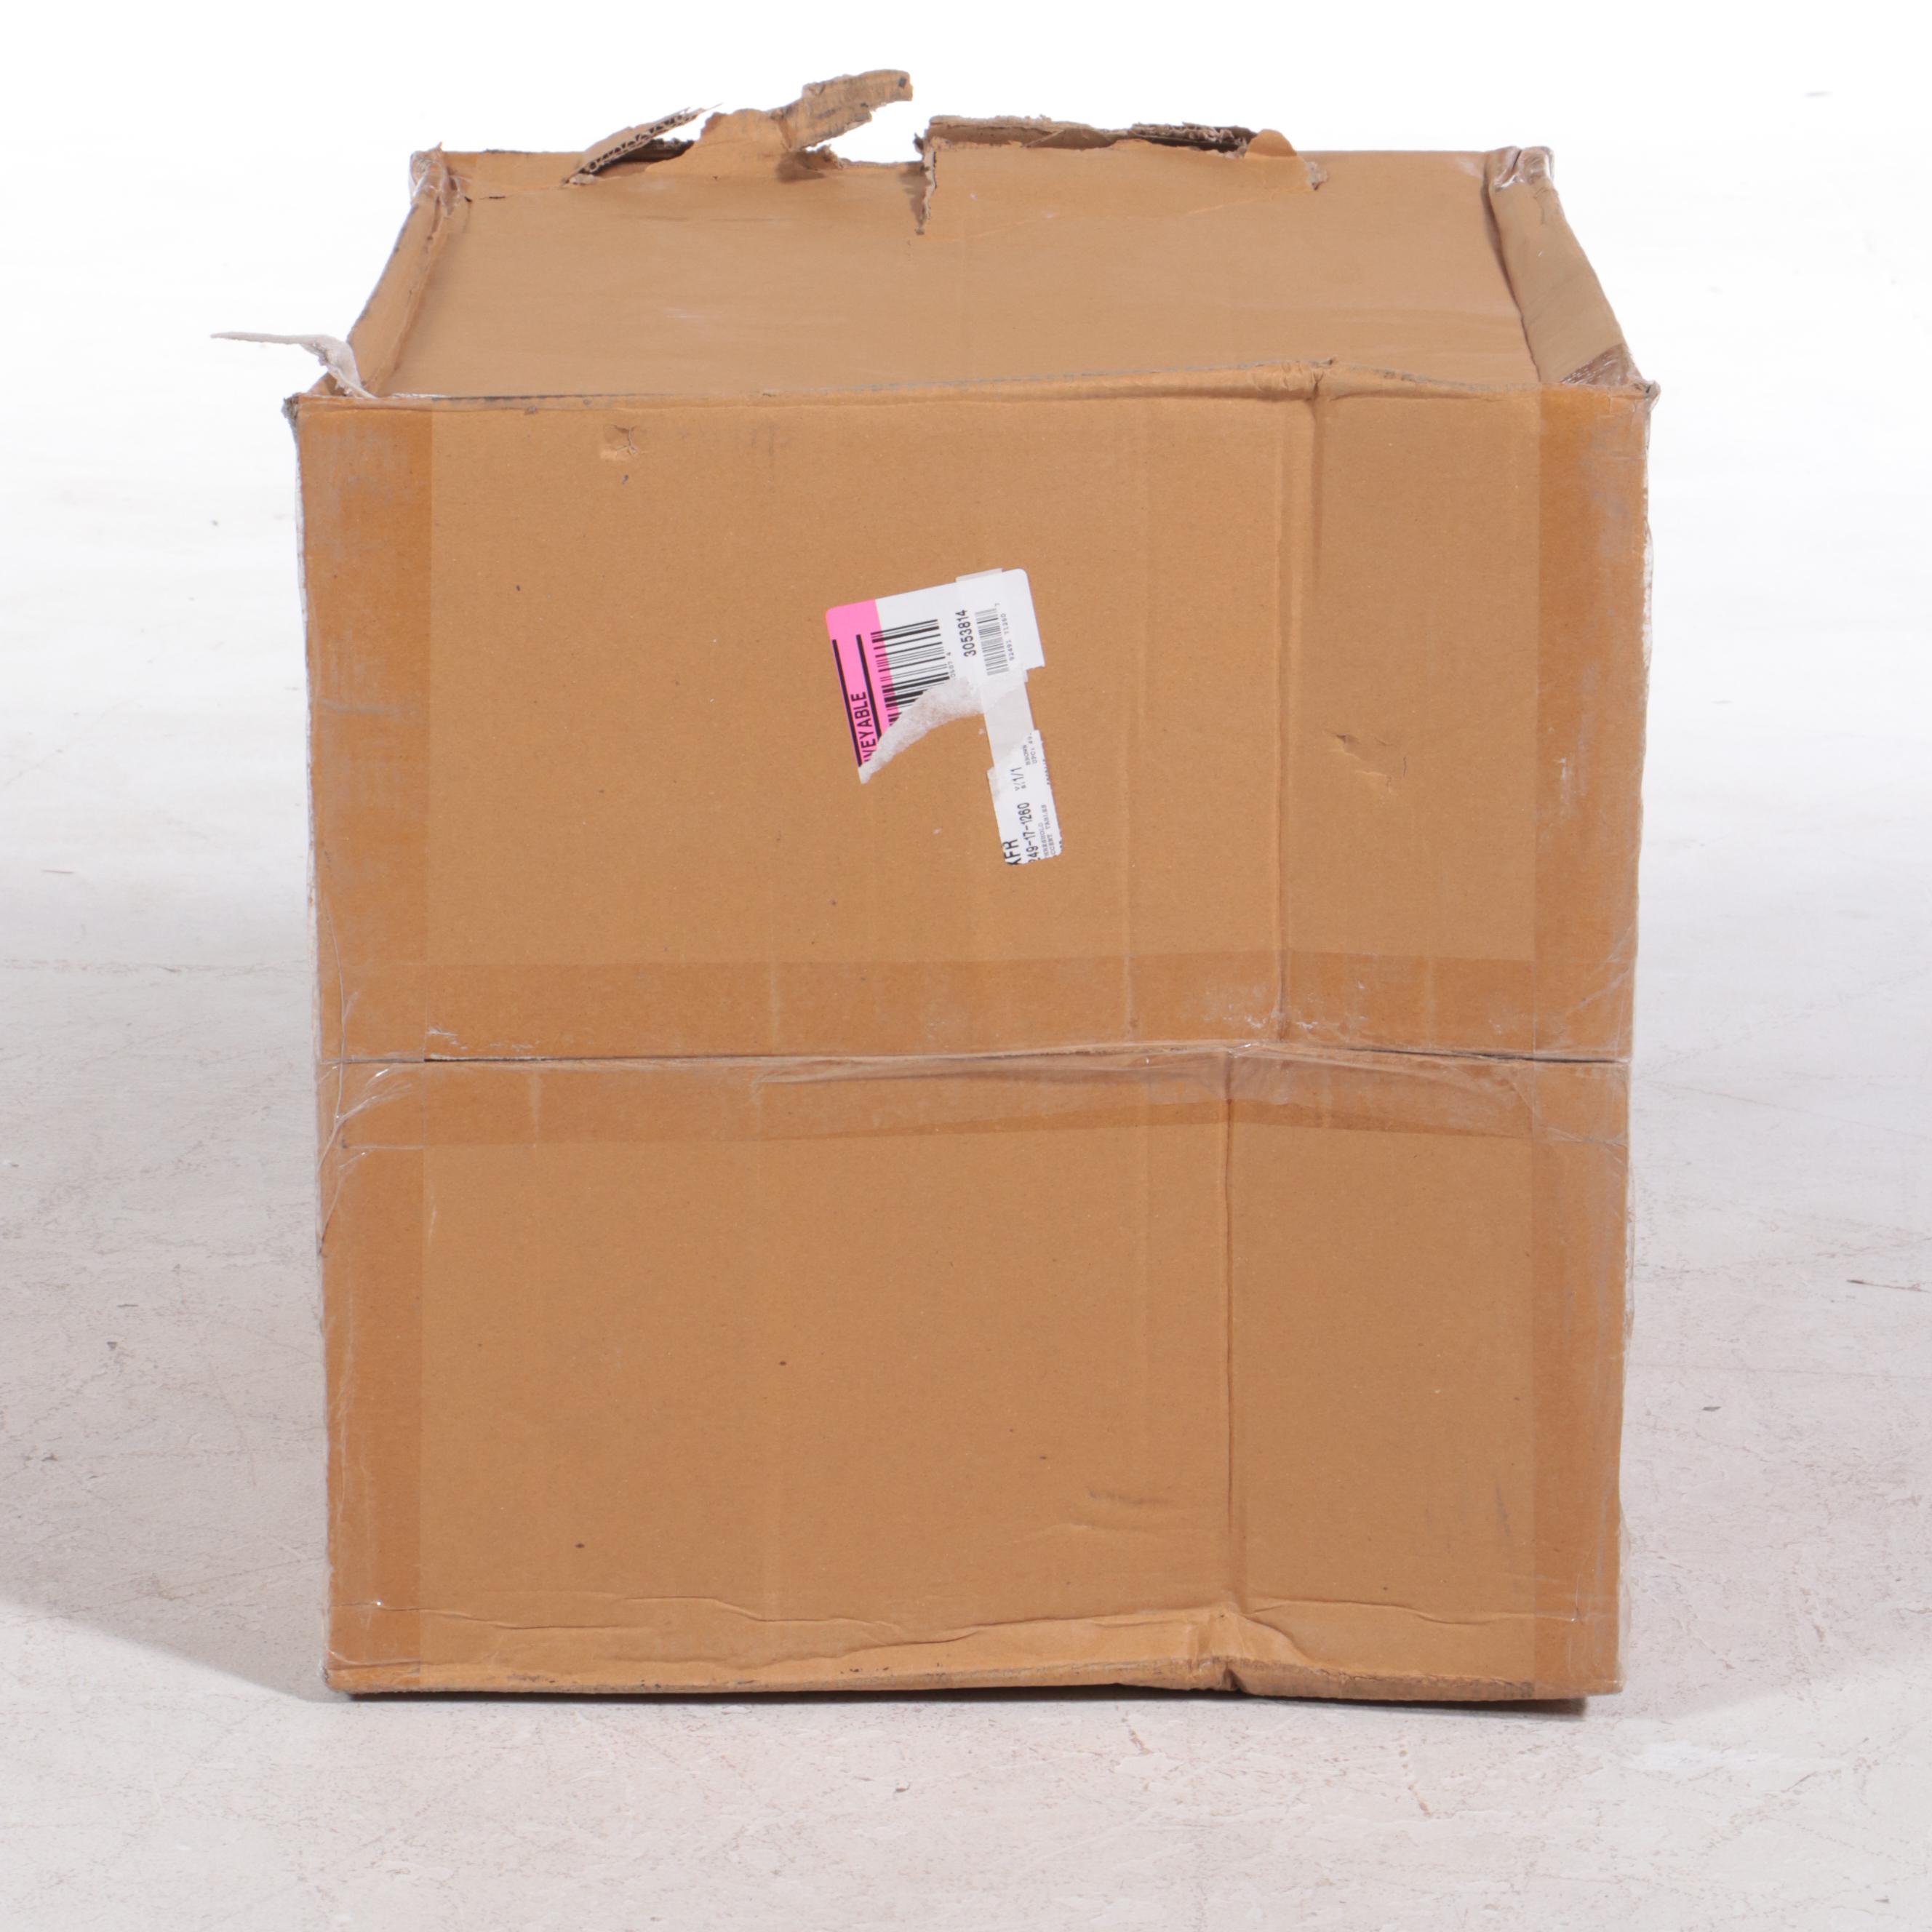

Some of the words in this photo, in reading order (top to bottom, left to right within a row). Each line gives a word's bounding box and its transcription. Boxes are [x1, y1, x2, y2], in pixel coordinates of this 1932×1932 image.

[955, 610, 977, 658] 3053814
[850, 691, 877, 762] VEYABLE
[1041, 804, 1050, 829] TABLES
[1038, 822, 1049, 858] HRESHOLD
[1047, 834, 1056, 856] CCENT
